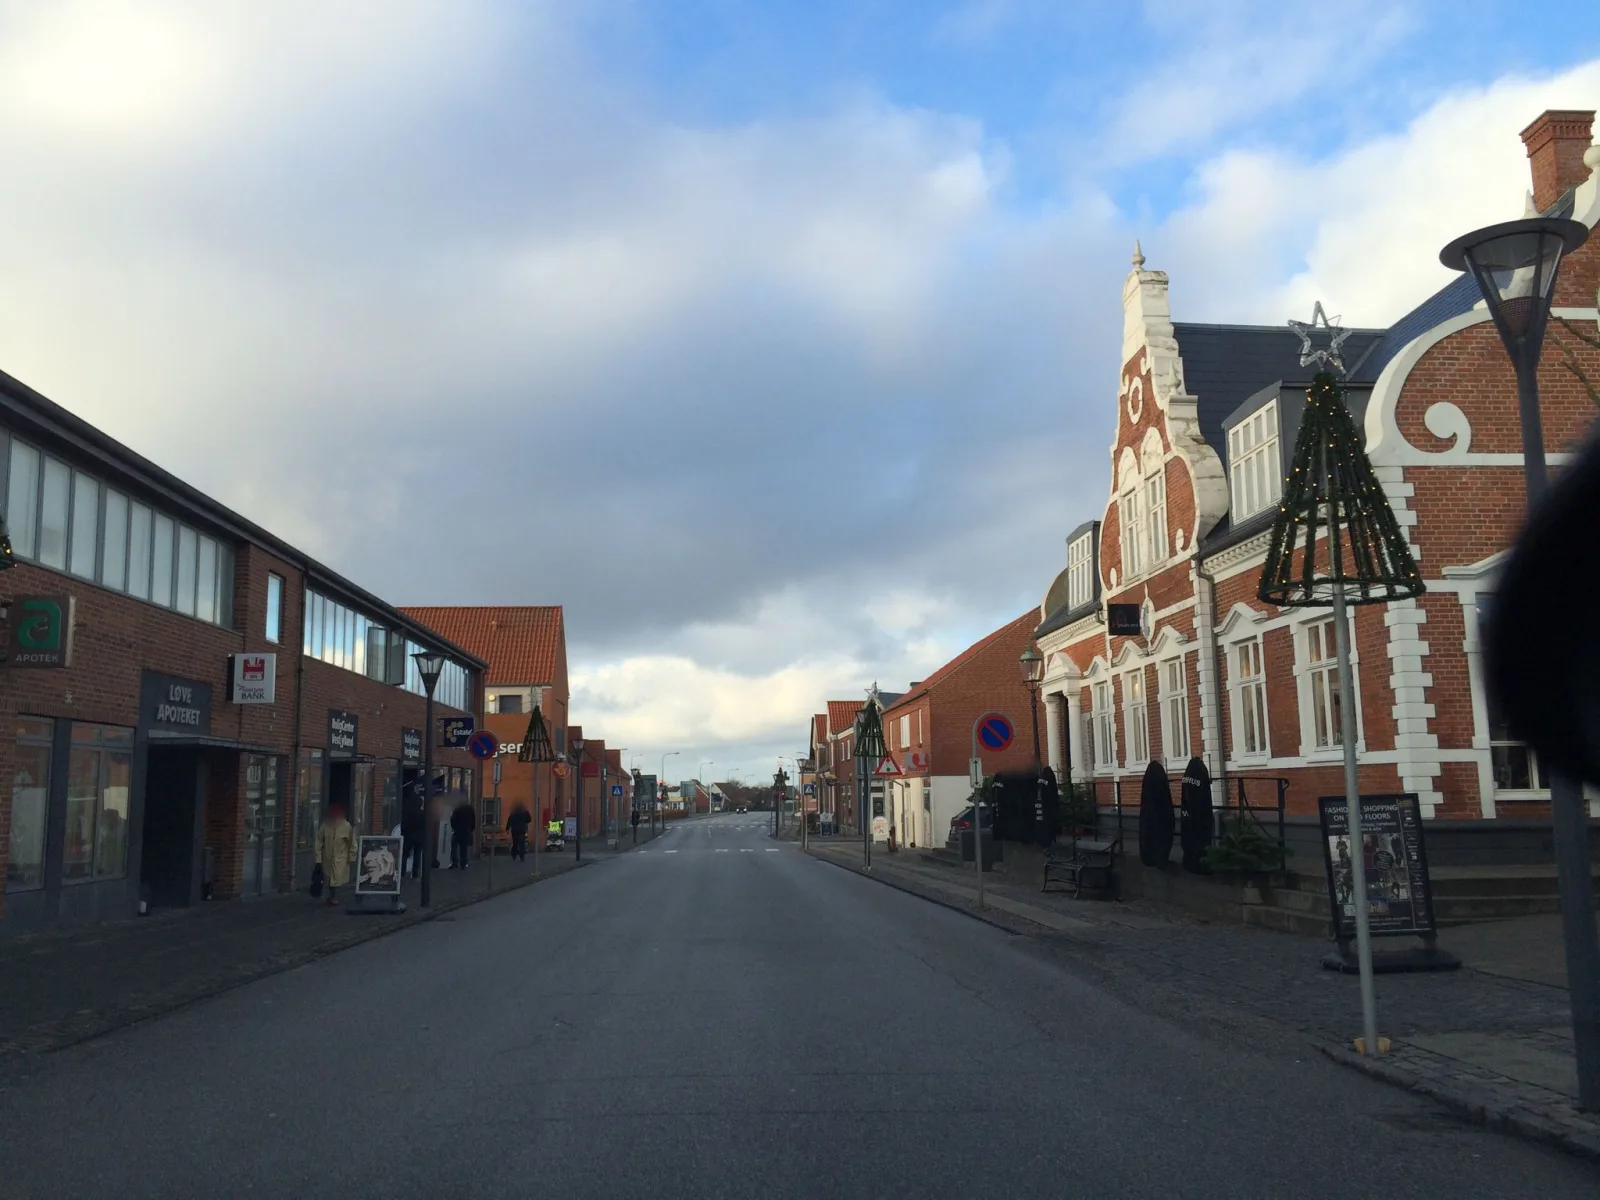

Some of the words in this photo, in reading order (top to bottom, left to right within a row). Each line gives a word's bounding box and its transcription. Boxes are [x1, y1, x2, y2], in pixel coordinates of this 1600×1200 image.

[15, 653, 59, 663] APOTEK
[169, 684, 193, 704] LØVE
[241, 692, 265, 700] BANK
[157, 704, 201, 726] APOTEKET
[1325, 806, 1349, 814] FASHIO
[1363, 804, 1398, 813] SHOPPING
